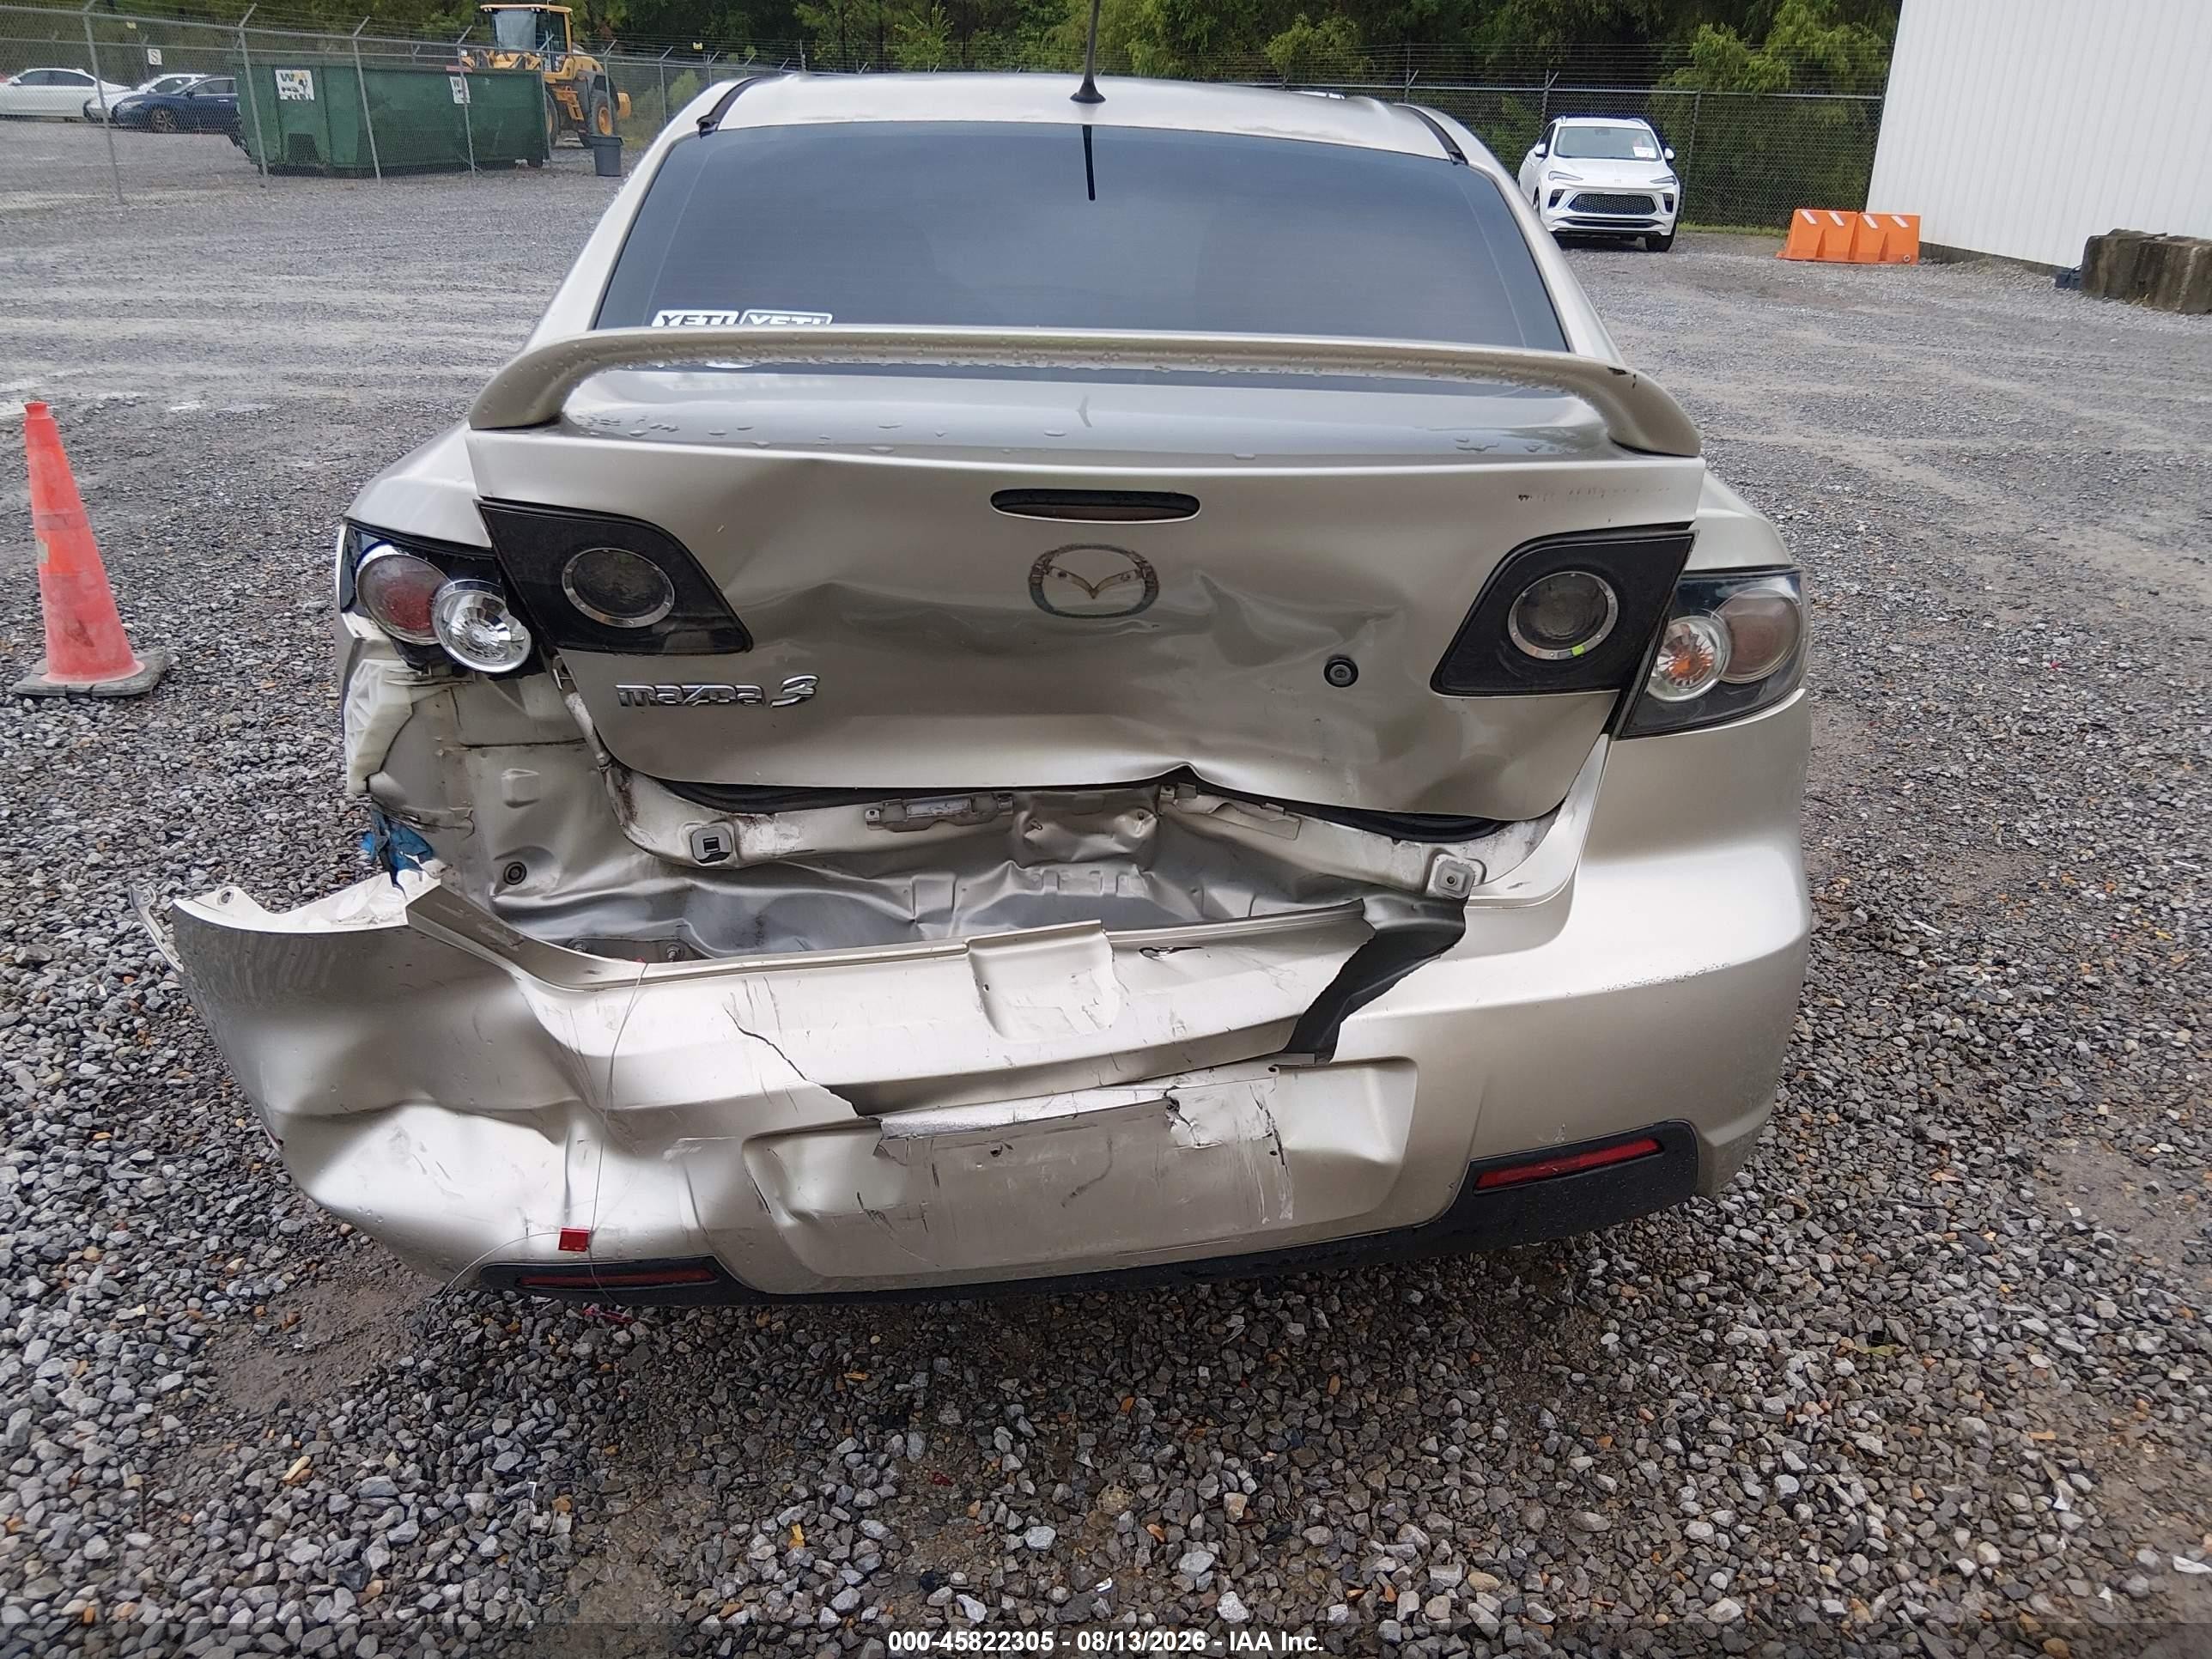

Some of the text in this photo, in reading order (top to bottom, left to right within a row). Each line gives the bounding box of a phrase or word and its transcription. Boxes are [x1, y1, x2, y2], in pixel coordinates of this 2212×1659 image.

[661, 314, 737, 327] YETI
[616, 674, 819, 708] mazda 3
